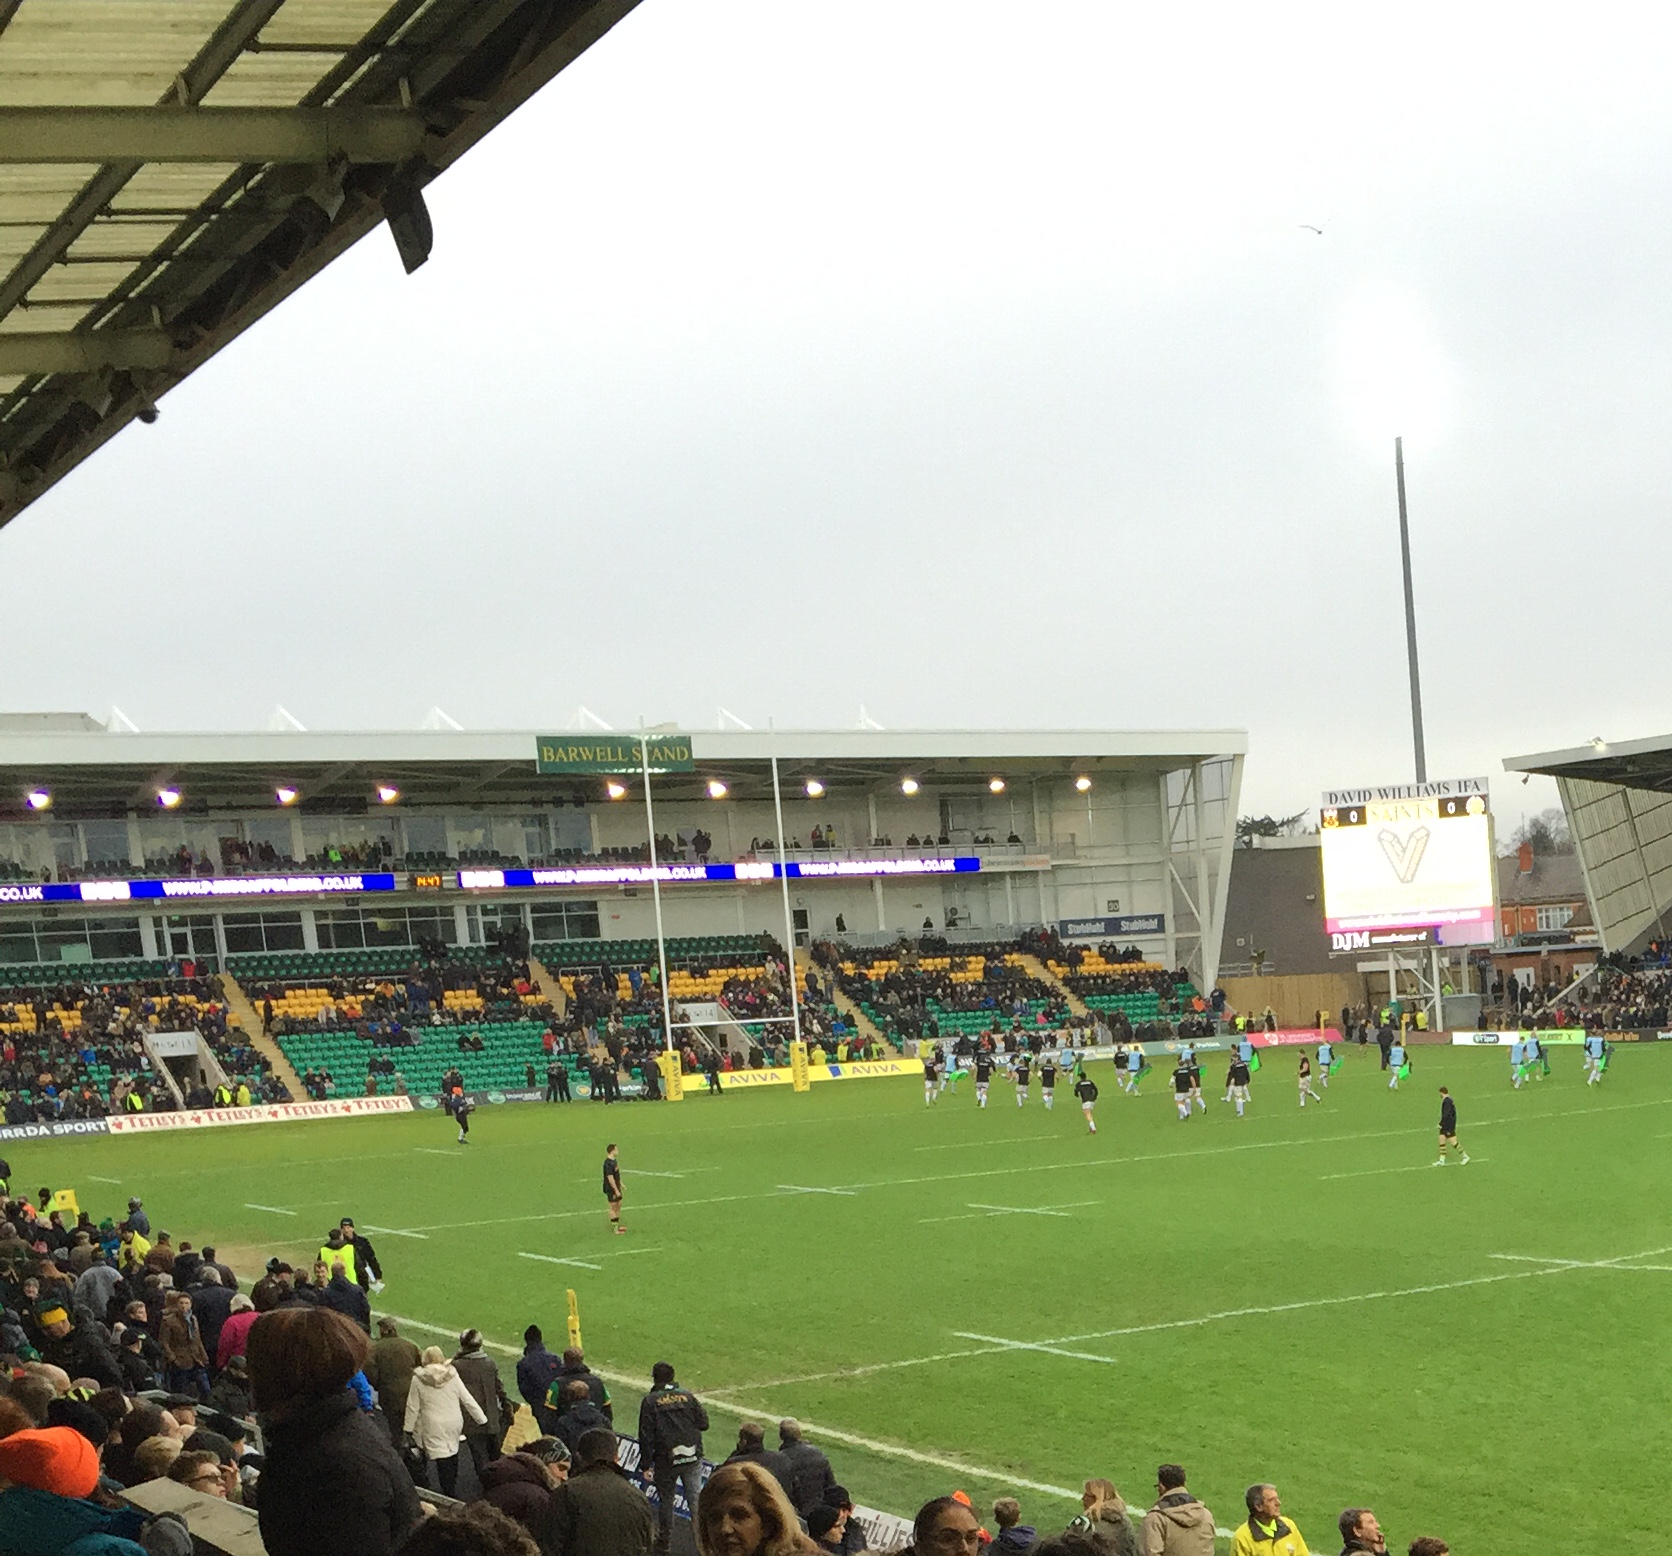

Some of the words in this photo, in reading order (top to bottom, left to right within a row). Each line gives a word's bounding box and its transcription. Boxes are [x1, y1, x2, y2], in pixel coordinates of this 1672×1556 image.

[542, 746, 628, 762] BARWELL
[632, 746, 689, 762] SAND
[1329, 790, 1372, 805] DAVID
[1378, 782, 1450, 801] WILLIAMS
[1457, 780, 1481, 794] IFA
[1332, 931, 1370, 951] DJM
[729, 1072, 781, 1085] AVIVA
[851, 1063, 901, 1077] AVIVA
[672, 1064, 682, 1098] AVIVA
[0, 1124, 50, 1139] RRDA
[53, 1120, 107, 1135] SPORT
